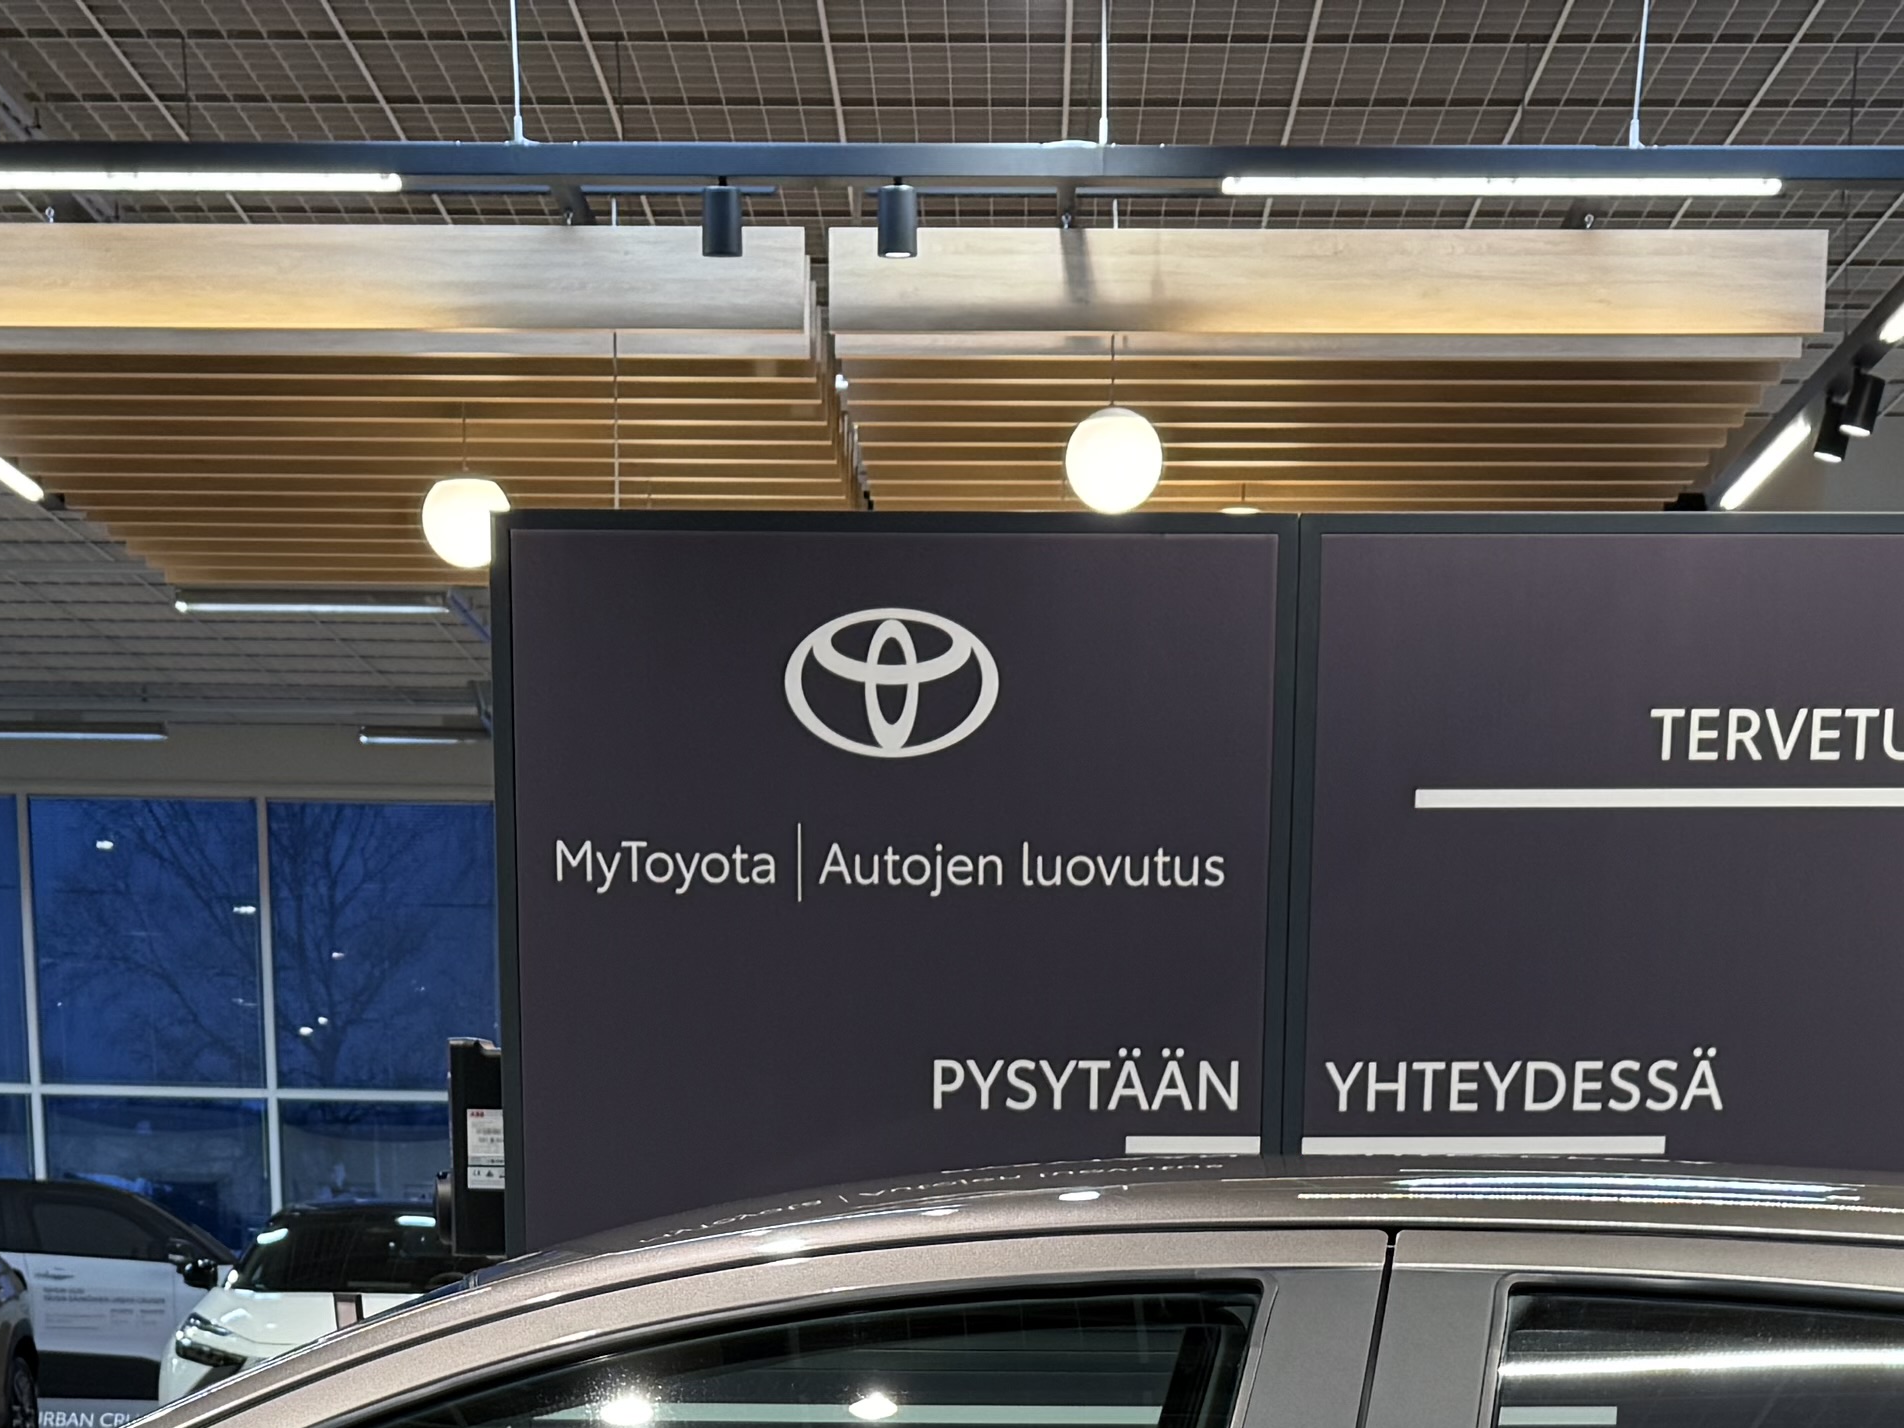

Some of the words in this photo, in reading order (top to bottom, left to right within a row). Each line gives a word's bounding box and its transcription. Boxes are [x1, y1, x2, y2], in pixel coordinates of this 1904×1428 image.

[556, 839, 776, 895] MyToyota
[819, 842, 1003, 897] Autojen
[1022, 841, 1225, 887] luovutus
[933, 1047, 1239, 1111] PYSYTÄÄN
[1325, 1047, 1723, 1112] YHTEYDESSÄ
